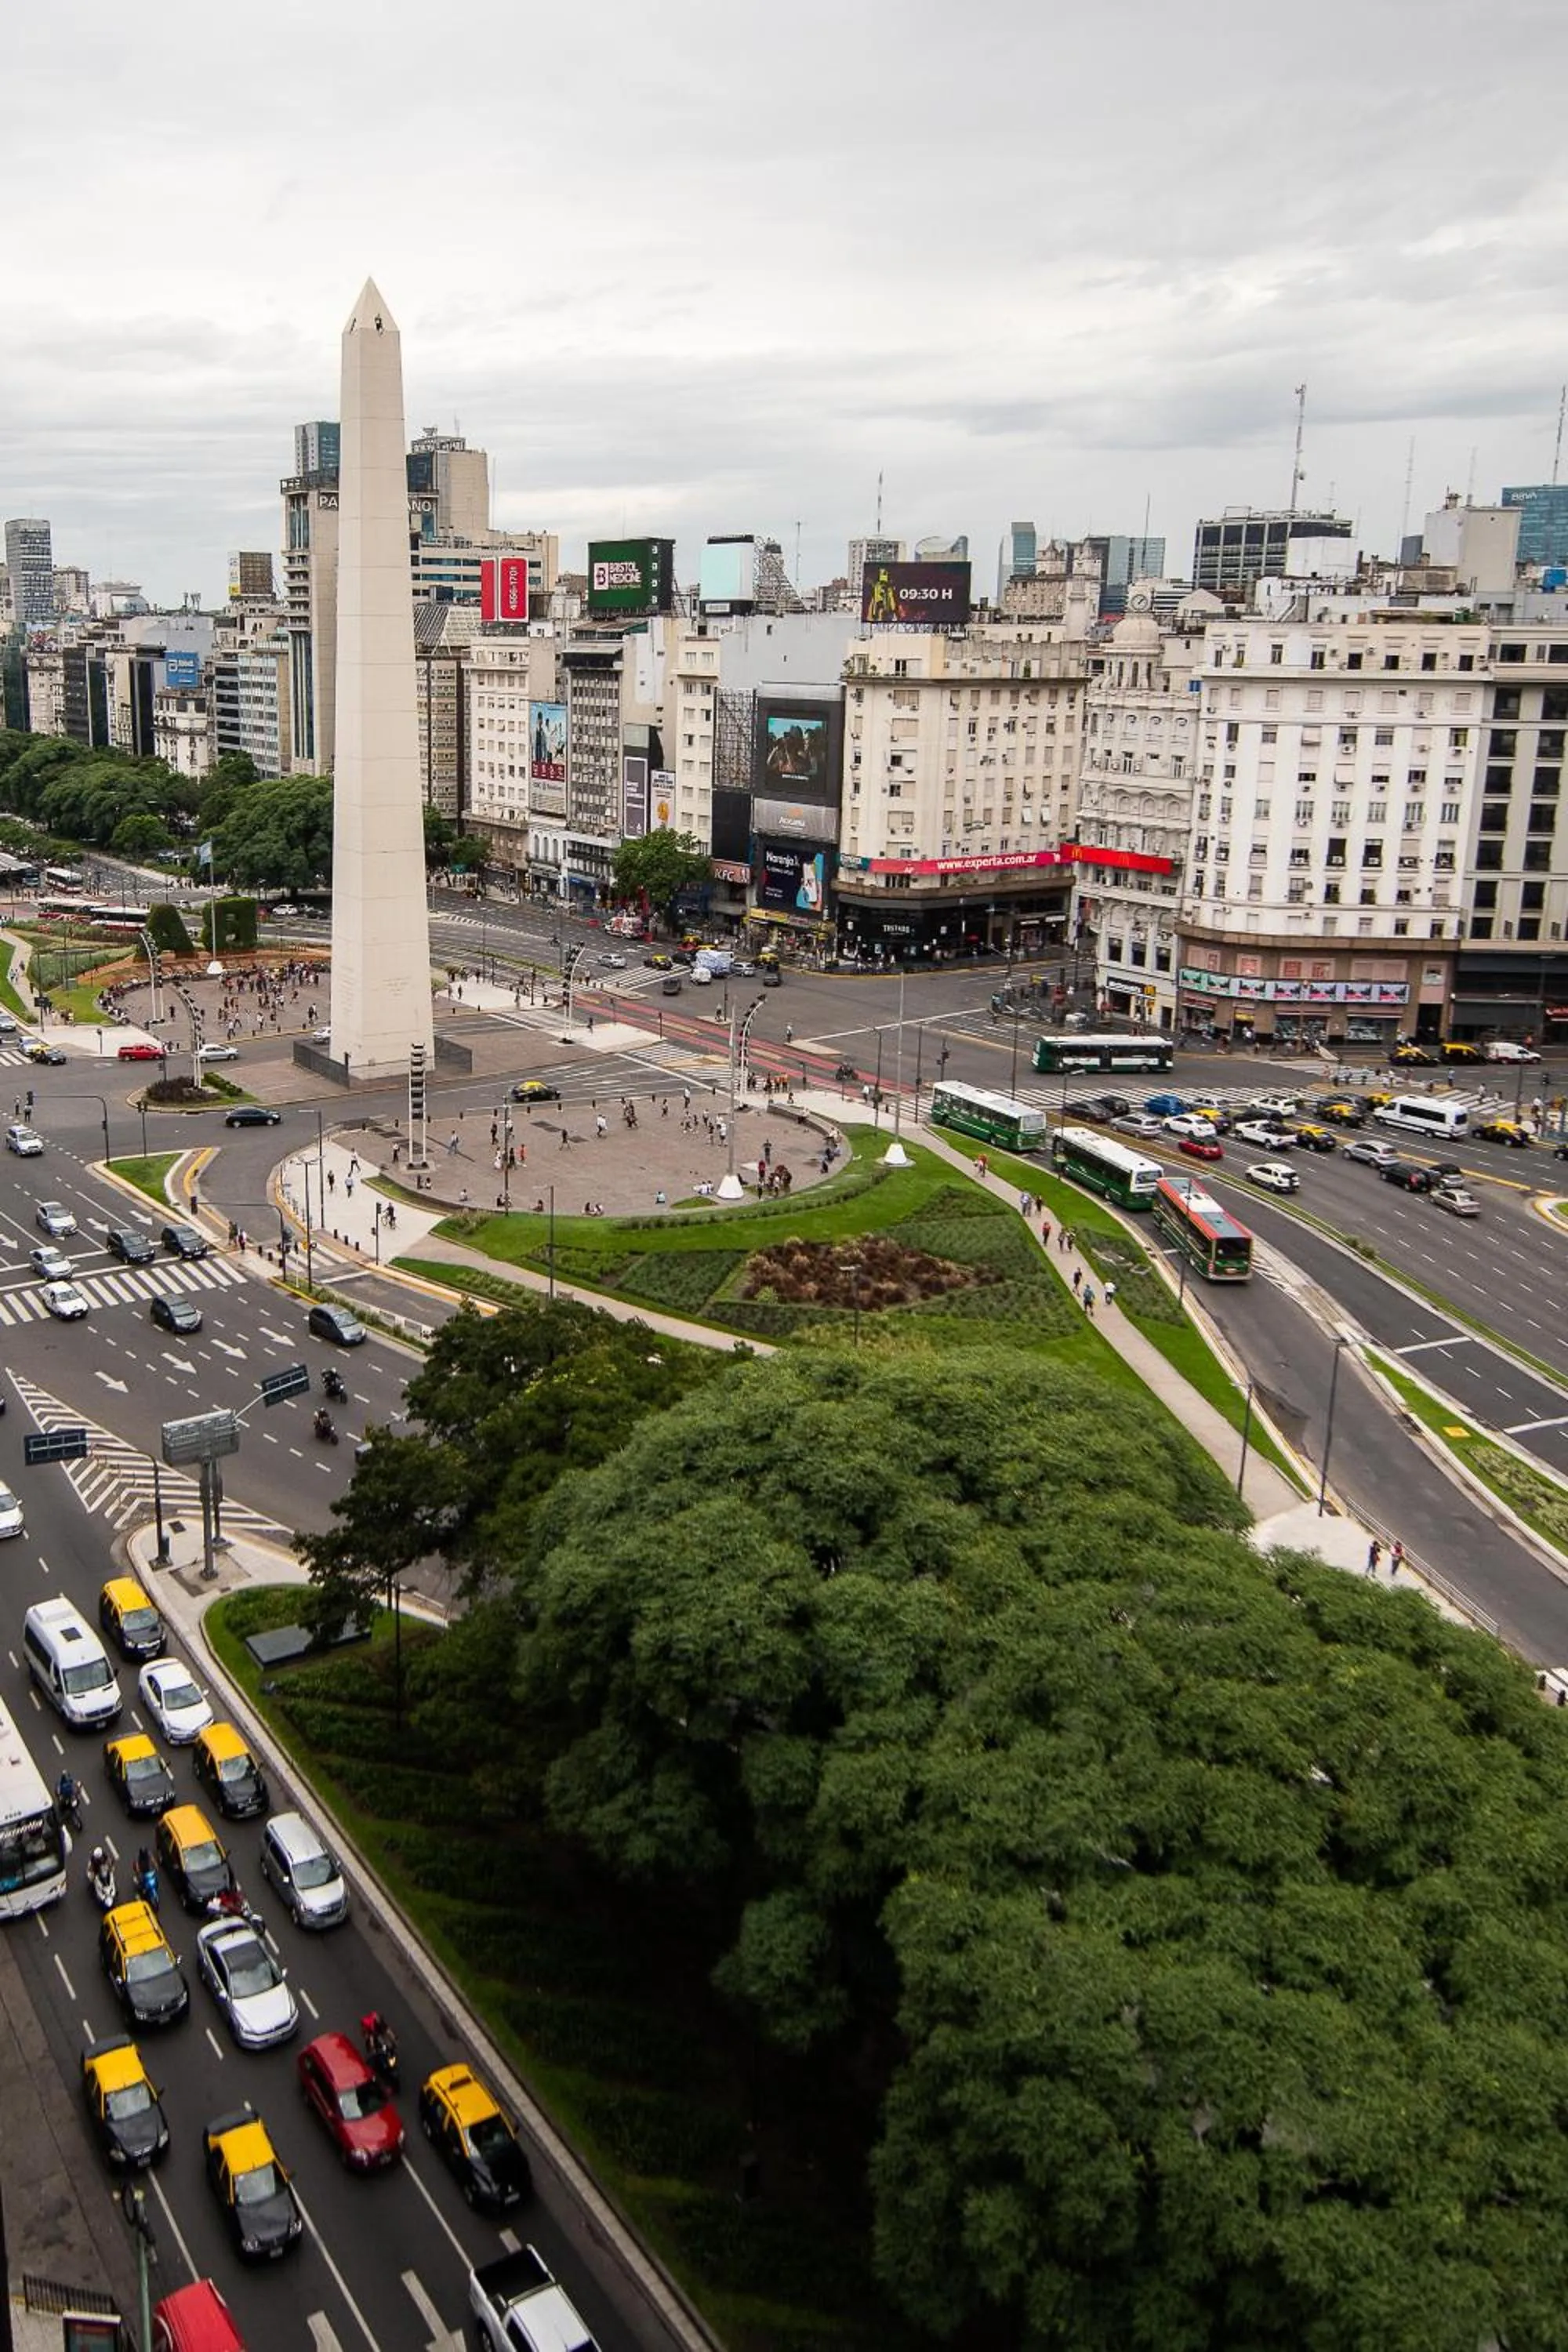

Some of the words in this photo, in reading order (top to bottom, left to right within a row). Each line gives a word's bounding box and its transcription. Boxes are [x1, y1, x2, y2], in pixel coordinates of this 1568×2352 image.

[899, 589, 938, 600] 09:30
[942, 589, 953, 600] H
[937, 853, 1036, 870] www.experta.com.ar
[714, 868, 735, 882] KFC
